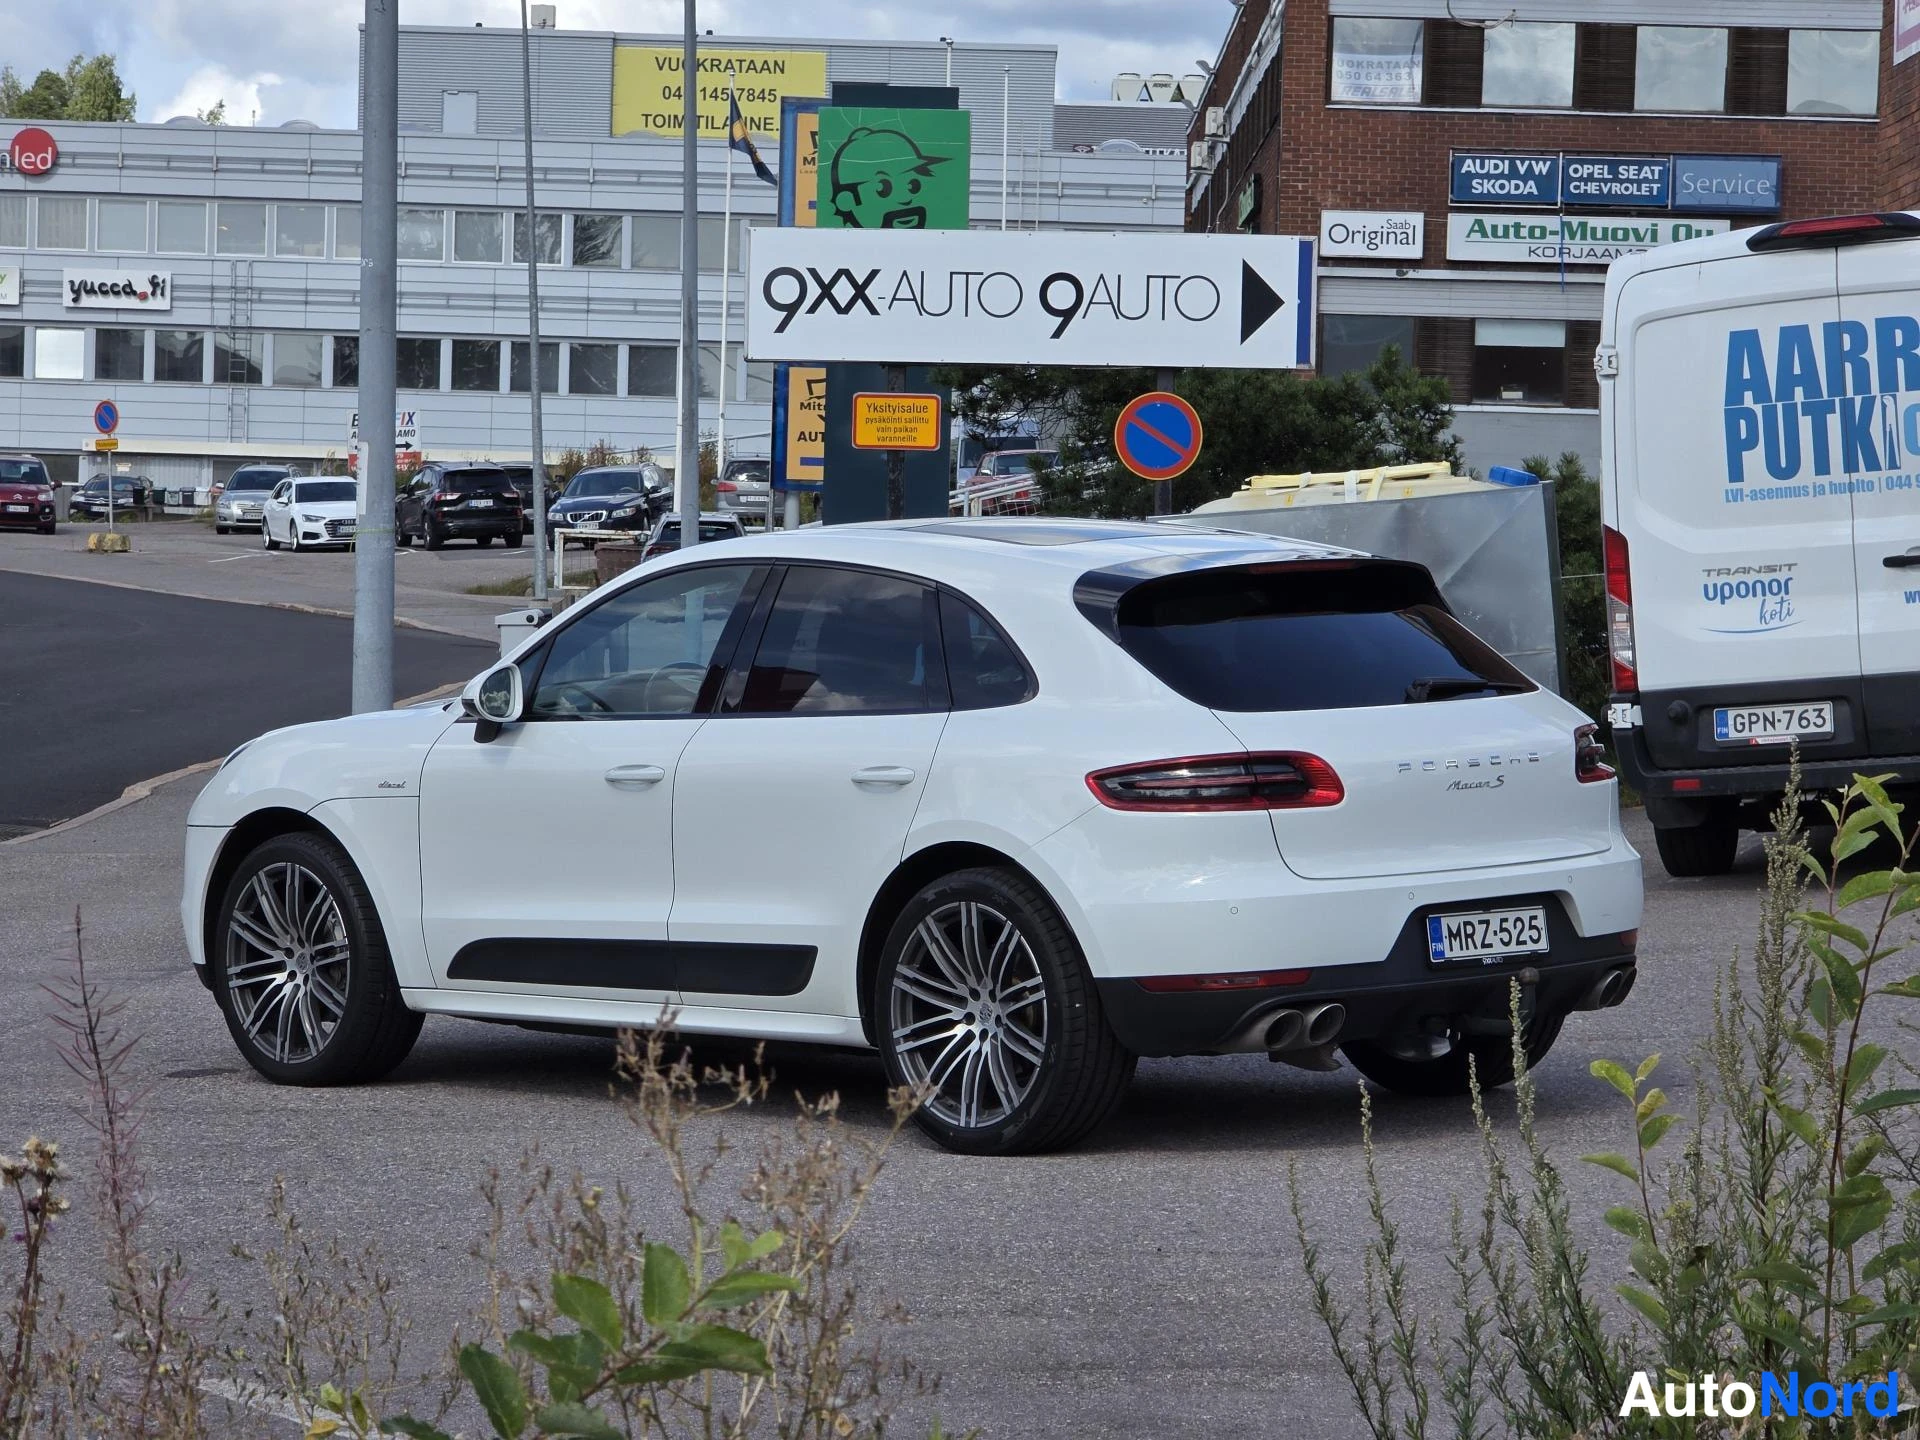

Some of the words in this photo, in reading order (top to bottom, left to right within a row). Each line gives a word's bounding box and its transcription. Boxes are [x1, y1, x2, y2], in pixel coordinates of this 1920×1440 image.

[655, 56, 785, 75] VUKRATAAN
[736, 88, 777, 103] 7845
[1461, 159, 1509, 174] AUDI
[1516, 160, 1551, 175] VW
[1568, 164, 1613, 179] OPEL
[1619, 165, 1663, 180] SEAT
[1471, 179, 1538, 195] SKODA
[1569, 182, 1661, 196] CHEVROLET
[1682, 173, 1770, 195] Service
[1386, 219, 1411, 230] Saab
[1465, 218, 1659, 243] Auto-Muovi
[1328, 222, 1416, 251] Original
[1528, 245, 1648, 260] KORJAAM
[762, 266, 1024, 334] 9XX-AUTO
[1038, 271, 1221, 339] 9AUTO
[866, 402, 929, 415] Yksityisalue
[865, 416, 903, 425] pysäköinti
[904, 416, 929, 425] sallittu
[876, 425, 892, 433] vain
[894, 425, 918, 435] paikan
[877, 434, 917, 442] varanneille
[1724, 484, 1810, 503] LVI-asennus
[1812, 482, 1826, 498] ja
[1828, 479, 1875, 495] huolto
[1885, 474, 1913, 491] 044
[1702, 563, 1798, 577] TRANSIT
[1703, 577, 1793, 605] uponor
[1759, 596, 1794, 625] koti
[1733, 707, 1827, 733] GPN-763
[1398, 752, 1540, 773] PORSCHE
[1446, 780, 1492, 791] Macan
[1490, 774, 1505, 789] S
[1446, 914, 1542, 952] MRZ-525
[1432, 942, 1444, 952] FIN
